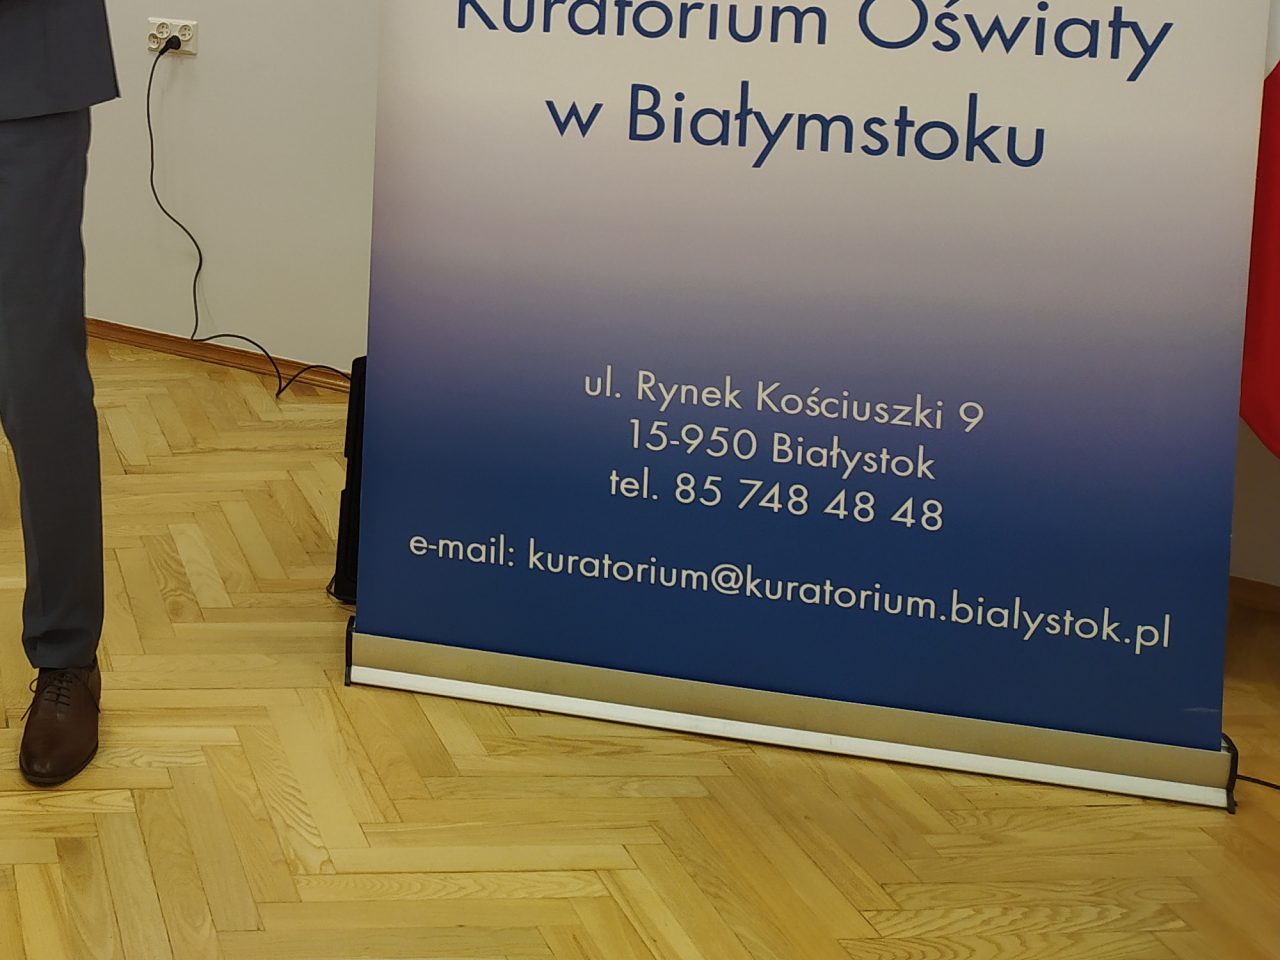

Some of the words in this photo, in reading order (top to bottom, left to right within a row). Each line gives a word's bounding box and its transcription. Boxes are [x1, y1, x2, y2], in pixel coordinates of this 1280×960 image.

[544, 99, 604, 139] w
[628, 79, 1045, 169] Białymstoku
[584, 364, 621, 399] ul.
[637, 369, 742, 412] Rynek
[757, 380, 944, 431] Kościuszki
[959, 401, 985, 433] 9
[628, 418, 757, 460] 15-950
[772, 432, 936, 480] Białystok
[609, 466, 659, 500] tel.
[673, 472, 722, 507] 85
[737, 478, 809, 516] 748
[823, 488, 875, 523] 48
[889, 496, 943, 531] 48
[409, 533, 515, 567] e-mail:
[528, 537, 1171, 655] kuratorium@kuratorium.bialystok.pl
